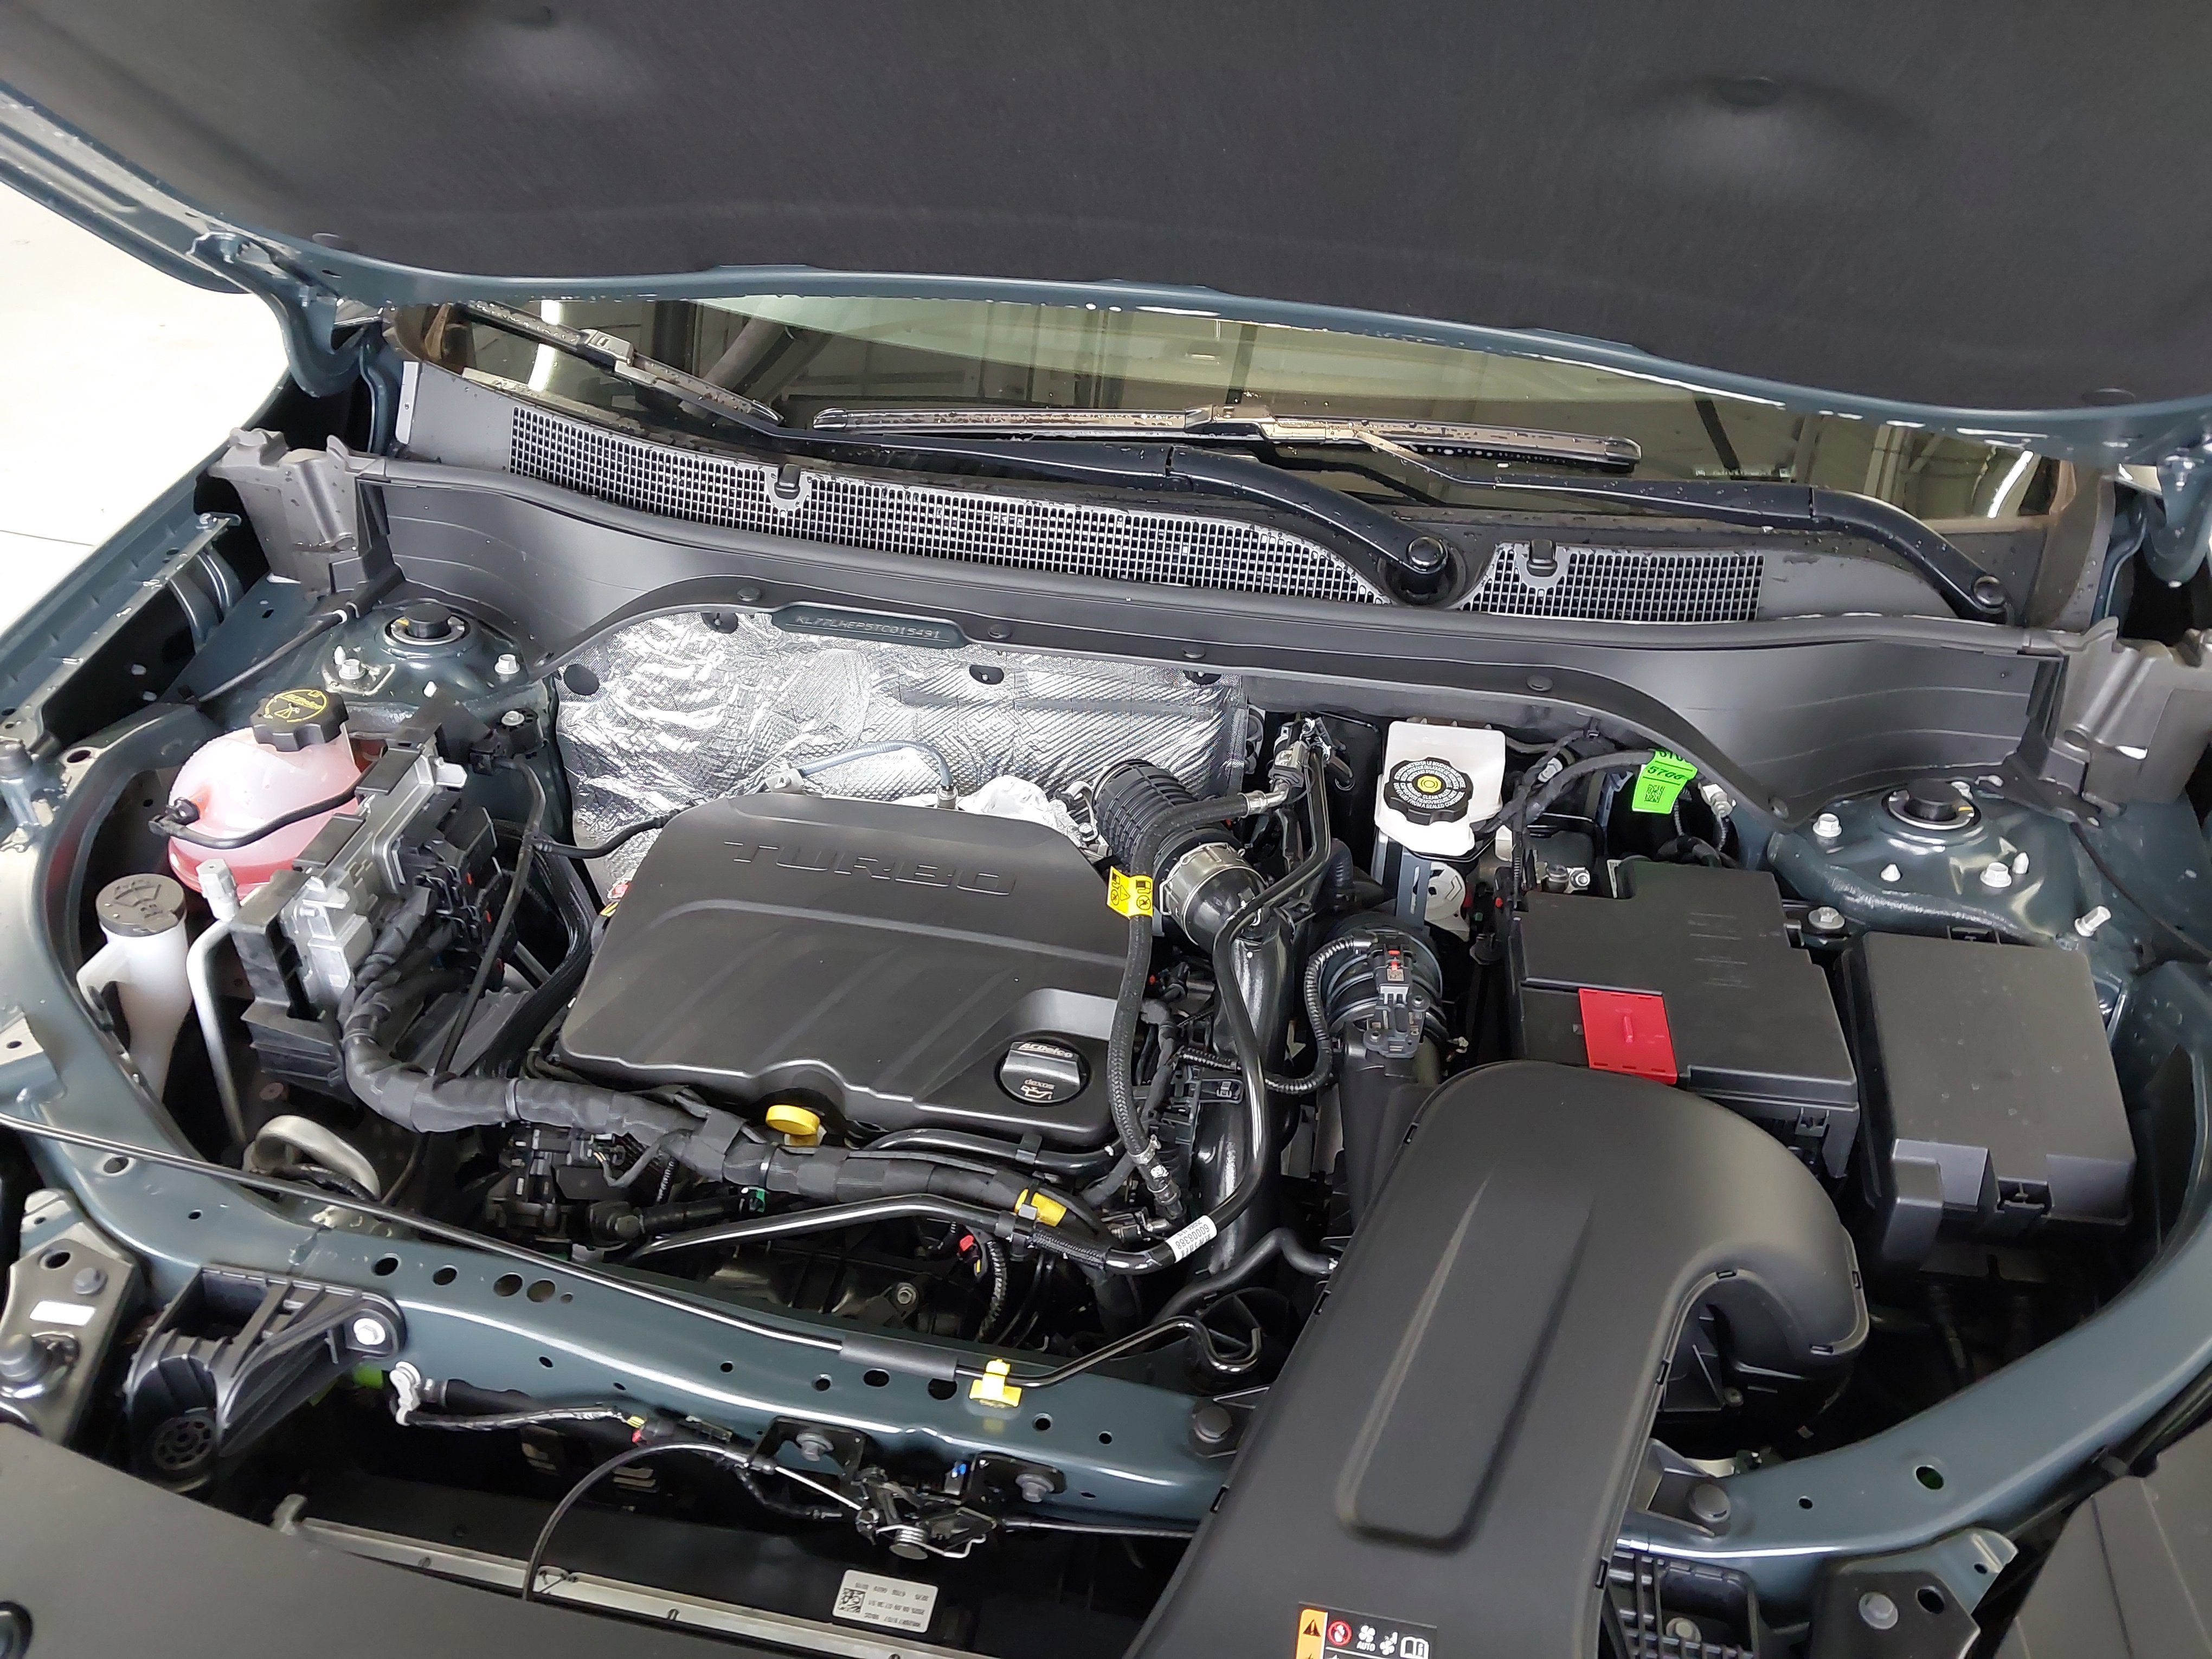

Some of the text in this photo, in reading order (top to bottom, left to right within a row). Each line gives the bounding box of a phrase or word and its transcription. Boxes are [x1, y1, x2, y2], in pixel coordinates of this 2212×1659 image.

[1407, 799, 1422, 807] FROM
[724, 840, 1017, 896] TURBO
[1018, 1042, 1073, 1058] ACDelco
[1024, 1078, 1056, 1090] dexos
[1356, 1641, 1376, 1651] AUTO
